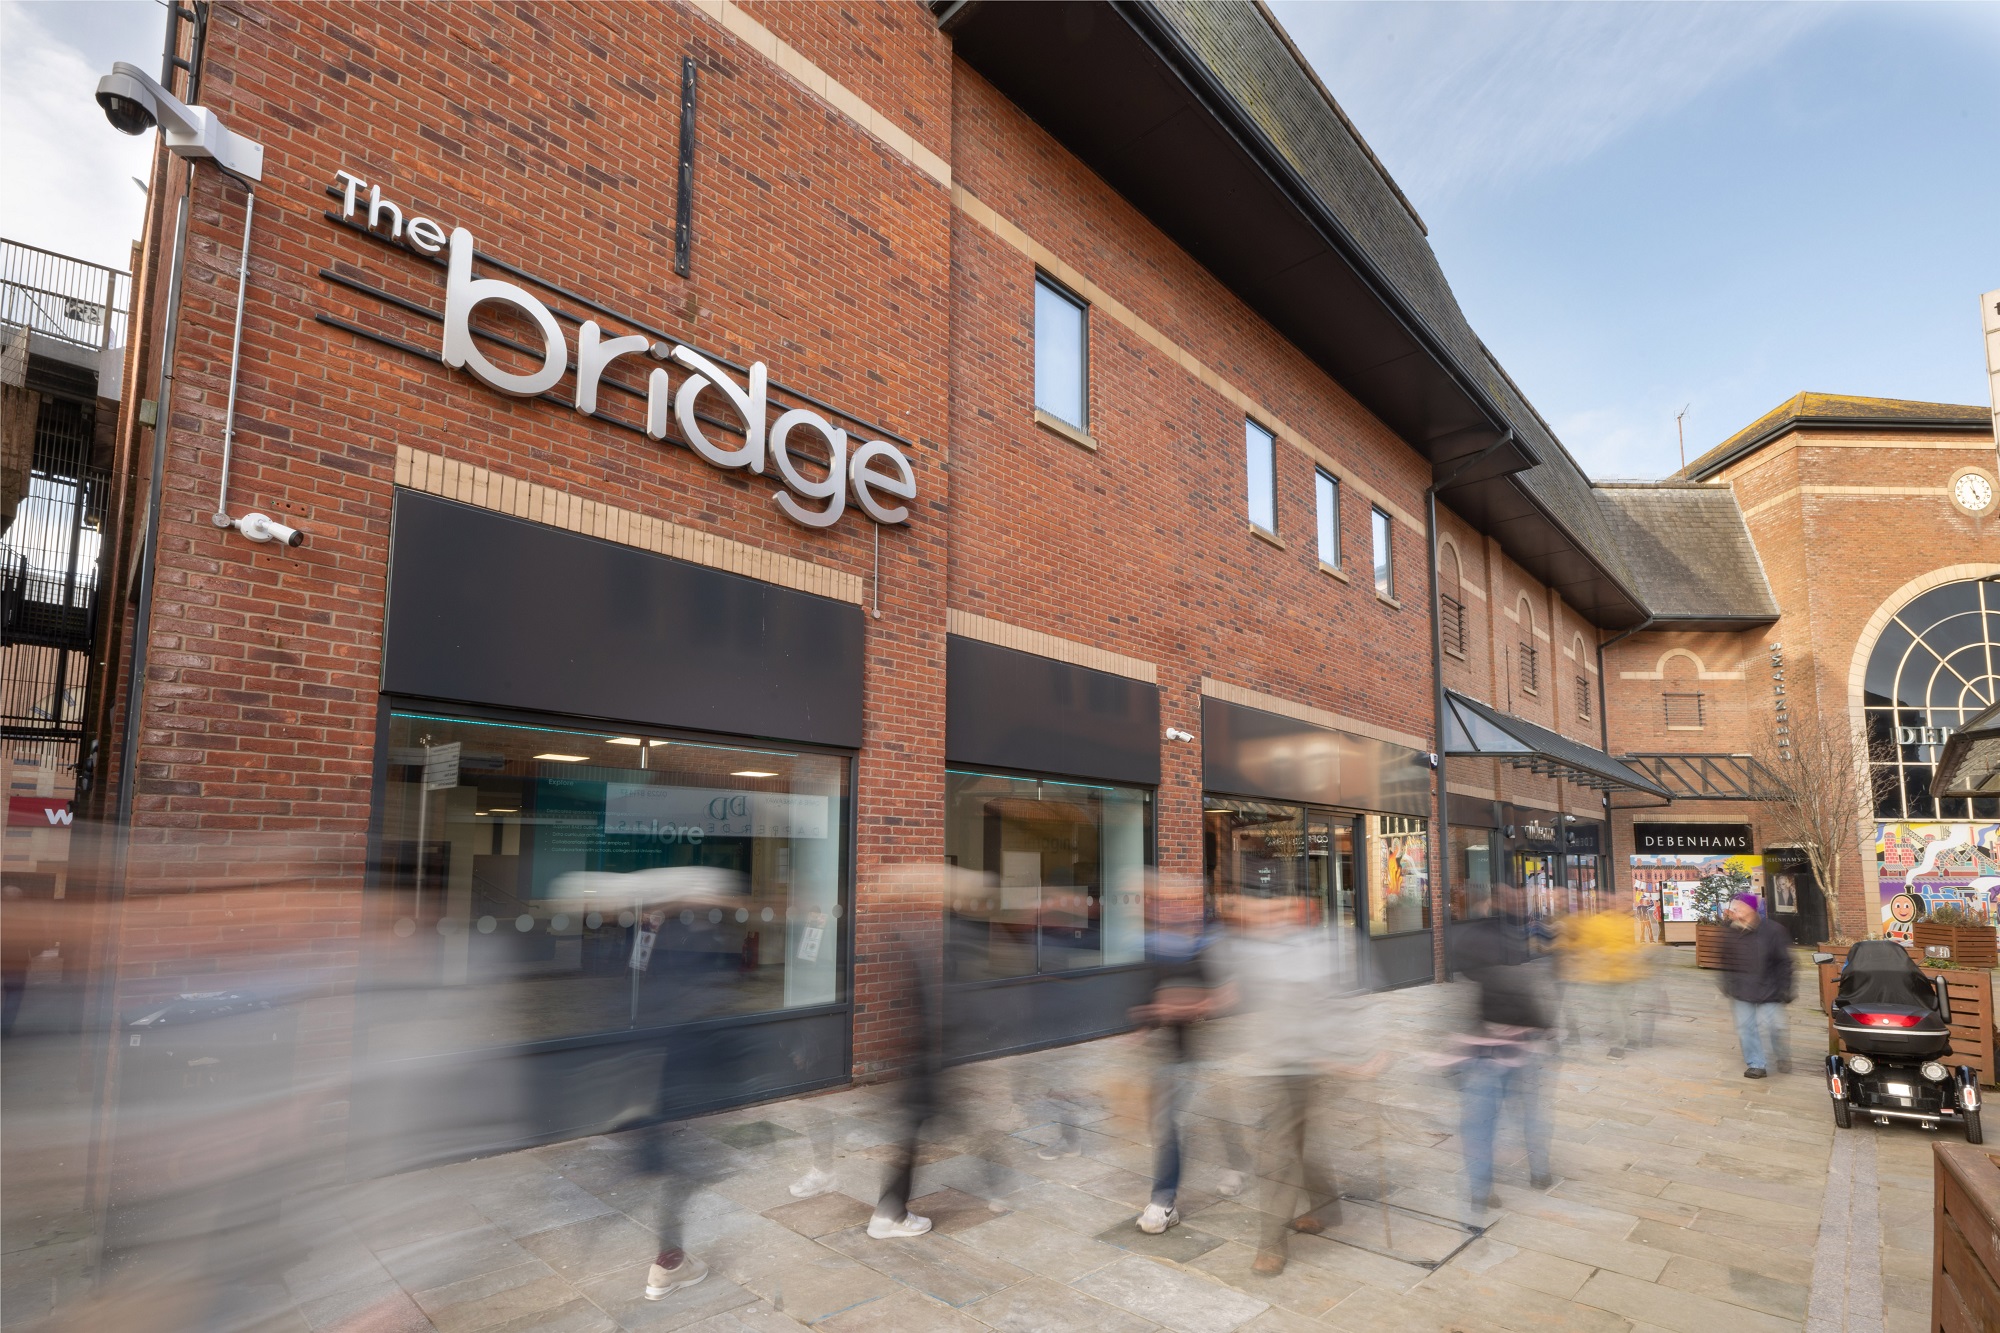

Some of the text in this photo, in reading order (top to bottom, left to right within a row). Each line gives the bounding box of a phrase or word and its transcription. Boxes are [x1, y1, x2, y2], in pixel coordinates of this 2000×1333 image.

[335, 169, 447, 256] The
[441, 226, 917, 528] bridge
[1769, 642, 1791, 761] DEBENHAMS
[548, 779, 575, 787] Explore
[1645, 835, 1747, 847] DEBENHAMS
